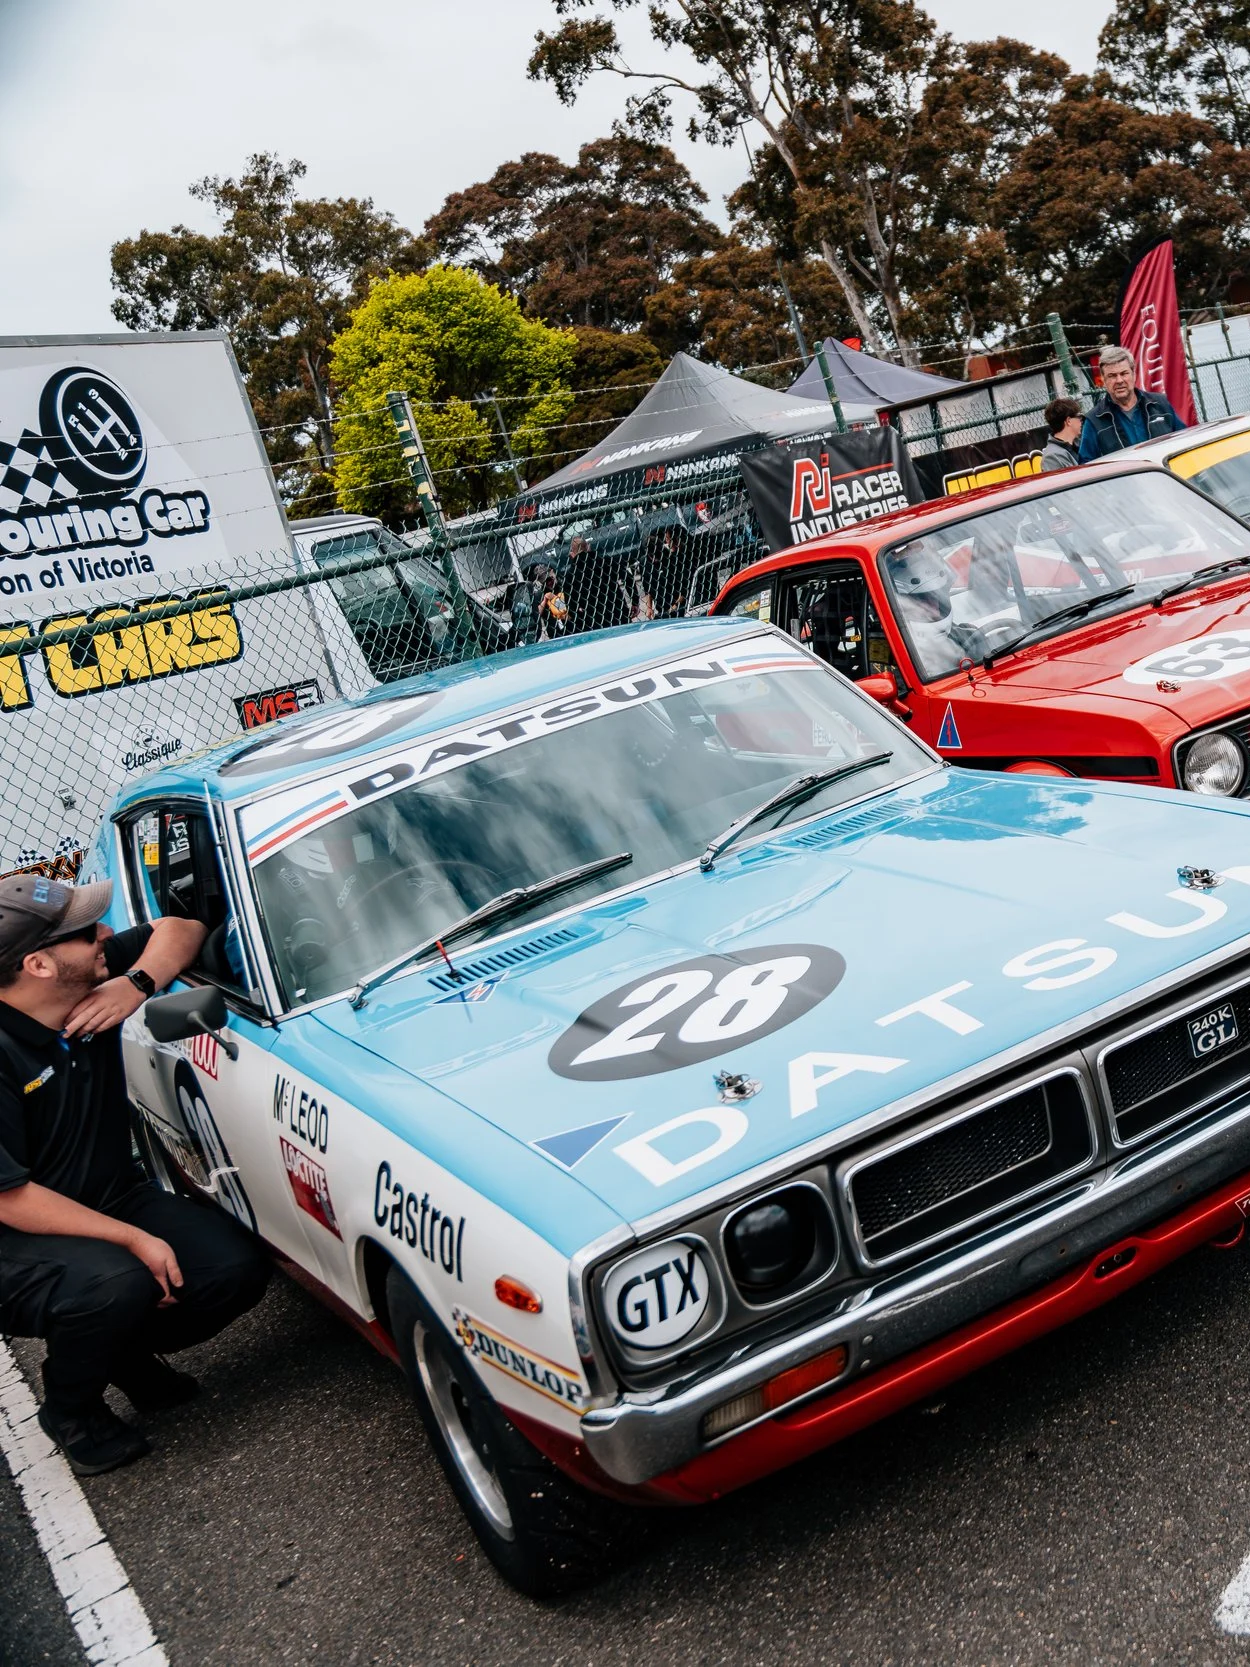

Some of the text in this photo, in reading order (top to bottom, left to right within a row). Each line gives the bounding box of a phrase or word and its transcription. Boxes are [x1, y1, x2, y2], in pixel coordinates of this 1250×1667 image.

[77, 402, 87, 411] 1
[88, 388, 99, 399] 3
[68, 414, 79, 427] R
[118, 448, 128, 461] 2
[129, 434, 137, 446] 4
[832, 470, 904, 508] RACER
[144, 494, 208, 532] Car
[39, 560, 65, 589] of
[67, 550, 156, 584] Victoria
[44, 586, 242, 697] CARS
[347, 660, 731, 801] DATSUN
[122, 738, 183, 771] Classique
[568, 955, 813, 1066] 28
[1191, 1005, 1233, 1036] 240K
[1197, 1023, 1236, 1053] GL
[282, 1140, 328, 1196] LOCTITE
[374, 1160, 467, 1283] Castrol
[616, 1250, 702, 1333] GTX
[475, 1329, 583, 1404] DUNLOP
